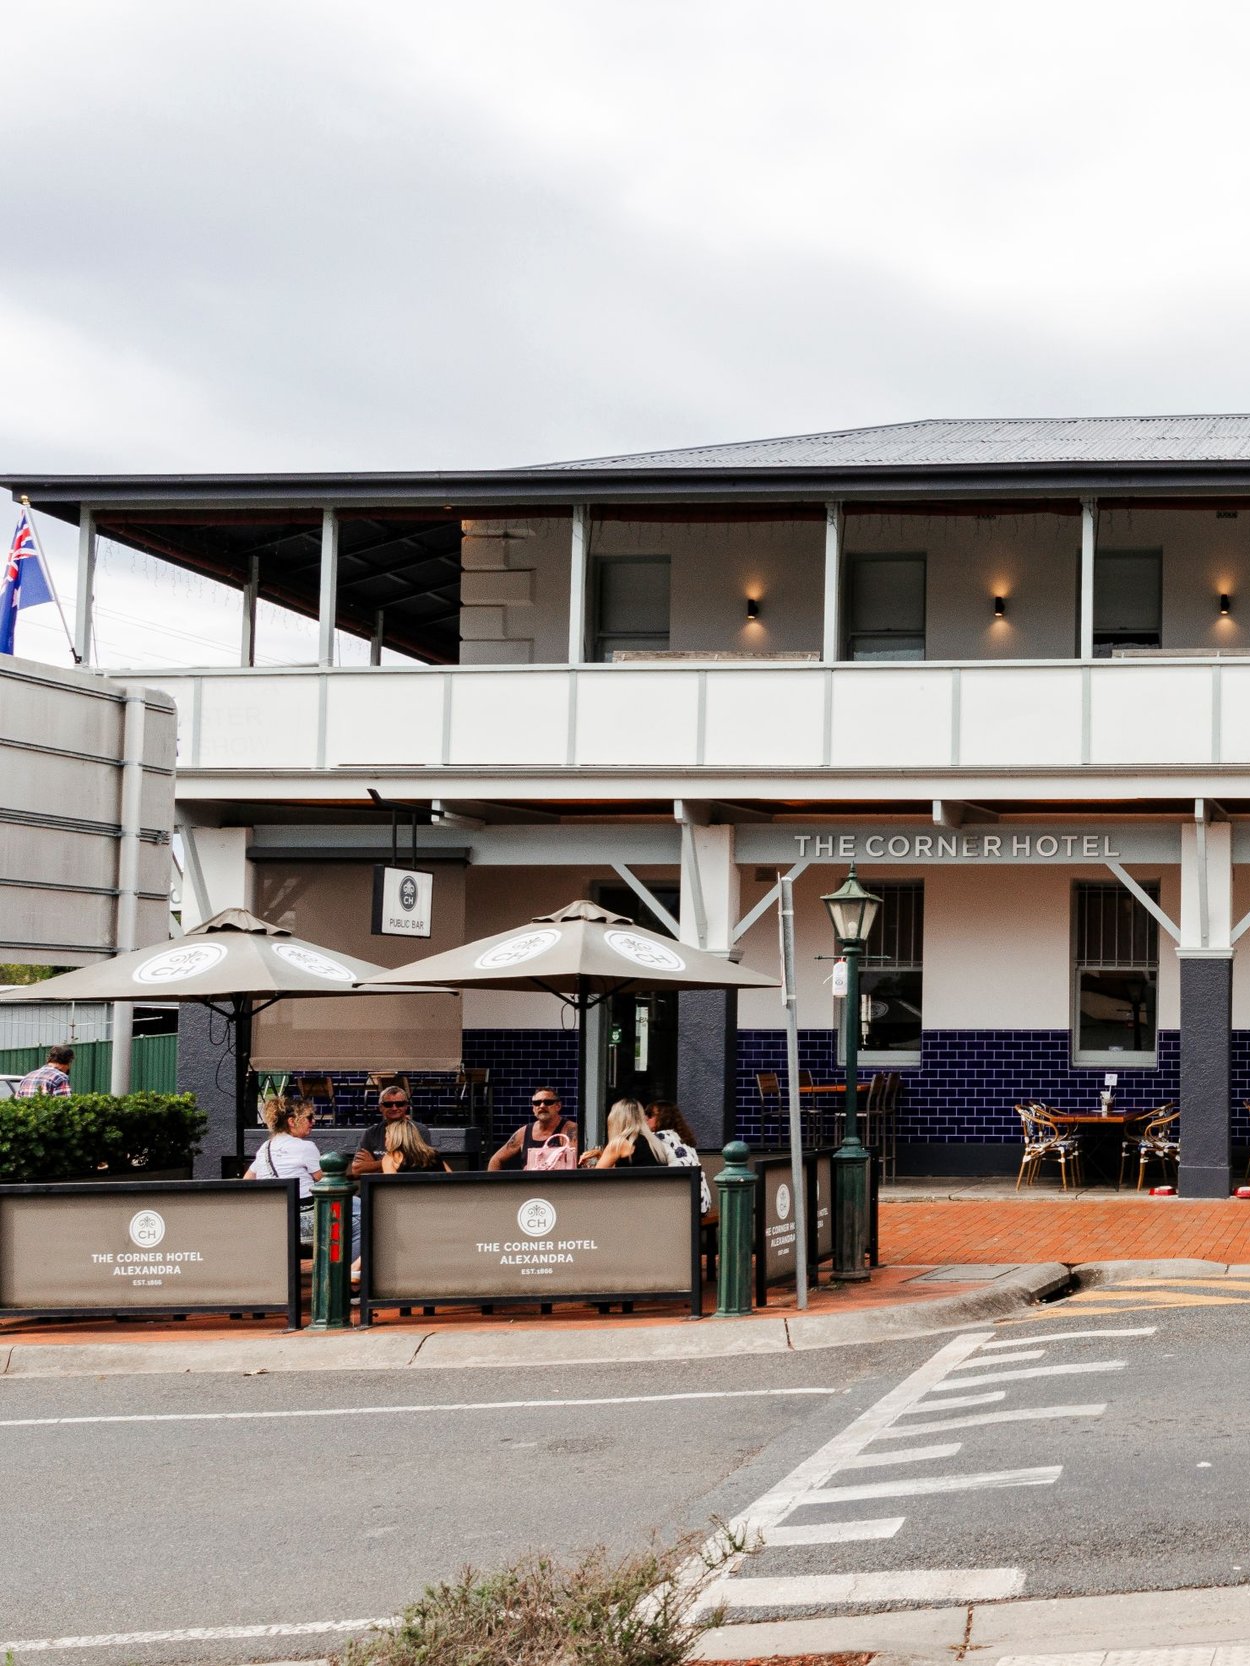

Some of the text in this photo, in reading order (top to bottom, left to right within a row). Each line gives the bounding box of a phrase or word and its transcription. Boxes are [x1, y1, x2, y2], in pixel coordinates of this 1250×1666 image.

[794, 835, 1120, 857] THE CORNER HOTEL
[403, 896, 414, 905] CH
[389, 918, 425, 930] PUBLIC BAR
[151, 964, 197, 977] CH
[526, 1219, 547, 1228] CH
[138, 1230, 156, 1240] CH
[476, 1240, 598, 1252] THE CORNER HOTEL
[91, 1251, 204, 1263] THE CORNER HOTEL
[500, 1253, 574, 1265] ALEXANDRA
[113, 1265, 181, 1276] ALEXANDRA
